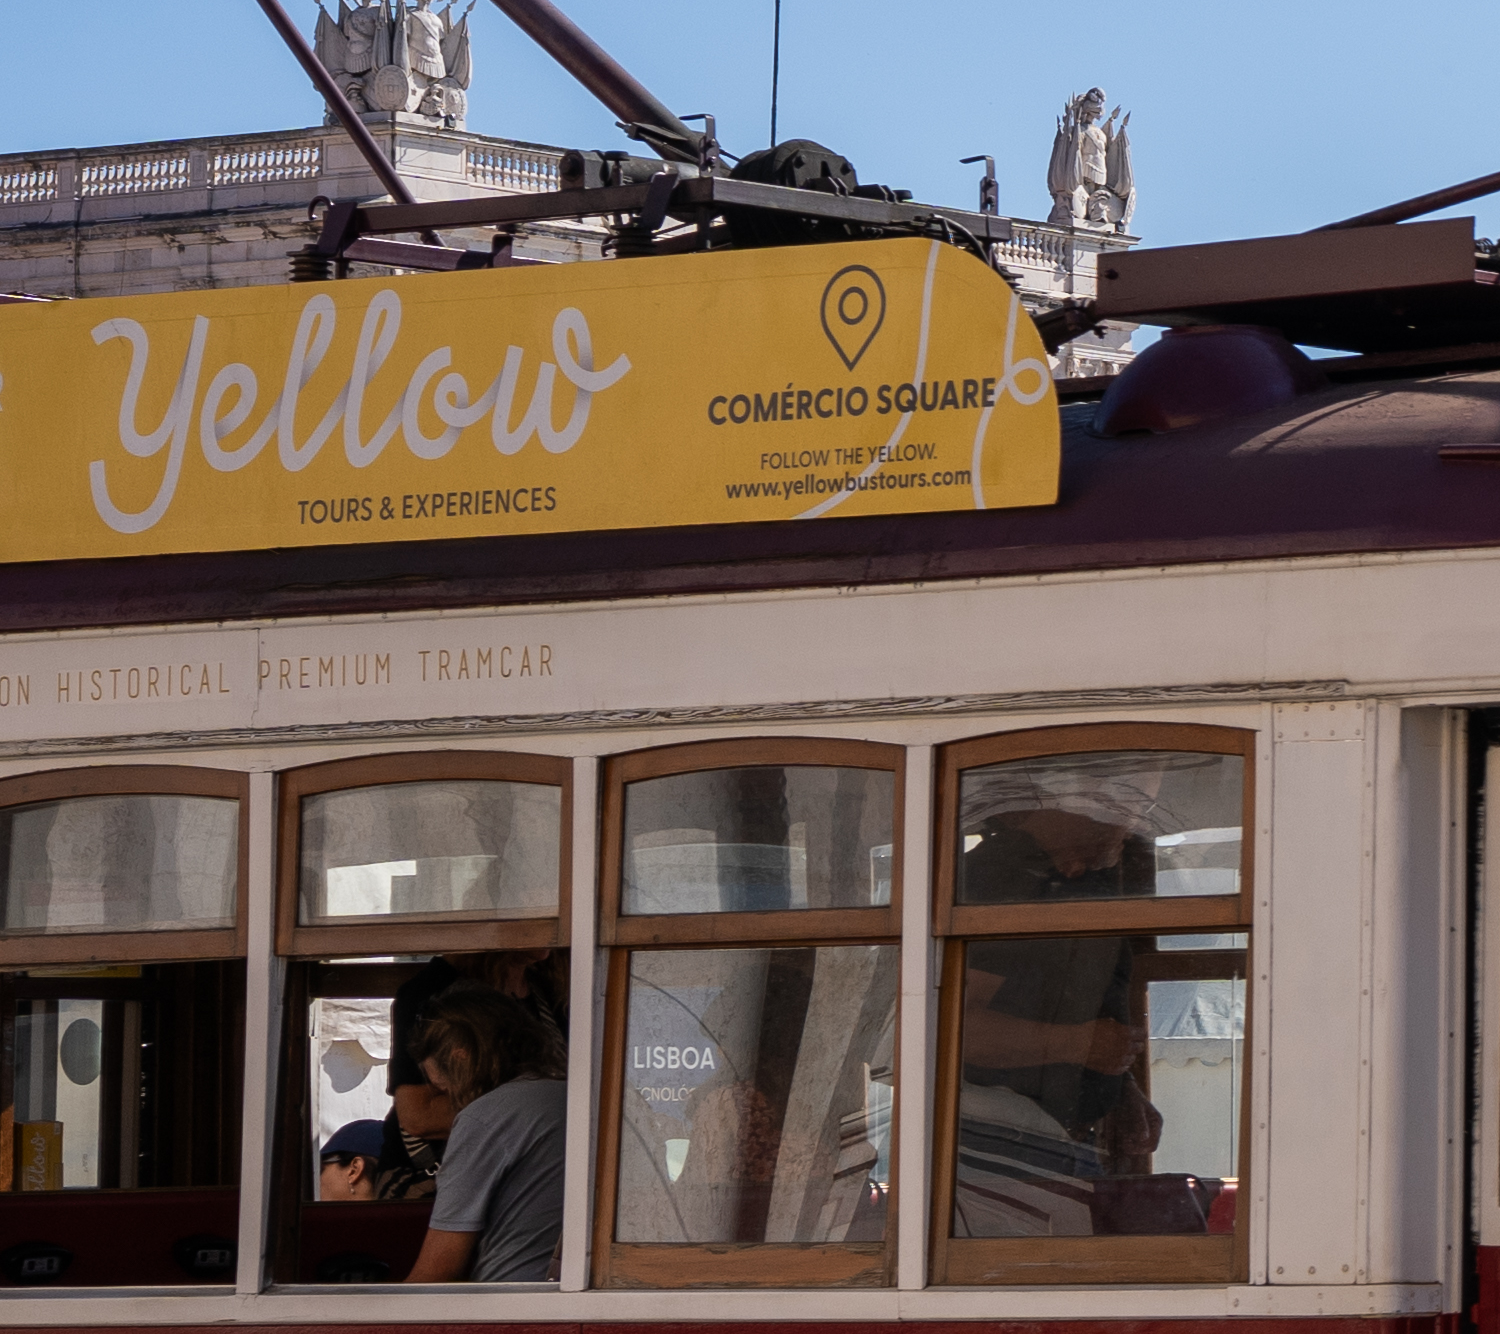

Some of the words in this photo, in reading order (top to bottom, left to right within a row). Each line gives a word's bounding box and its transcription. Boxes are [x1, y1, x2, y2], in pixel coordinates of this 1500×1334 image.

[708, 383, 869, 425] COMÉRCIO
[876, 378, 996, 415] SQUARE
[760, 449, 830, 471] FOLLOW
[835, 447, 863, 465] THE
[868, 443, 938, 464] YELLOW.
[725, 468, 972, 500] www.yellowbustours.com
[298, 497, 372, 524] TOURS
[379, 496, 395, 520] &
[402, 486, 556, 519] EXPERIENCES
[58, 663, 230, 703] HISTORICAL
[258, 653, 390, 690] PREMIUM
[418, 644, 552, 681] TRAMCAR
[634, 1046, 715, 1069] LISBOA
[636, 1084, 696, 1102] CNOLÓ
